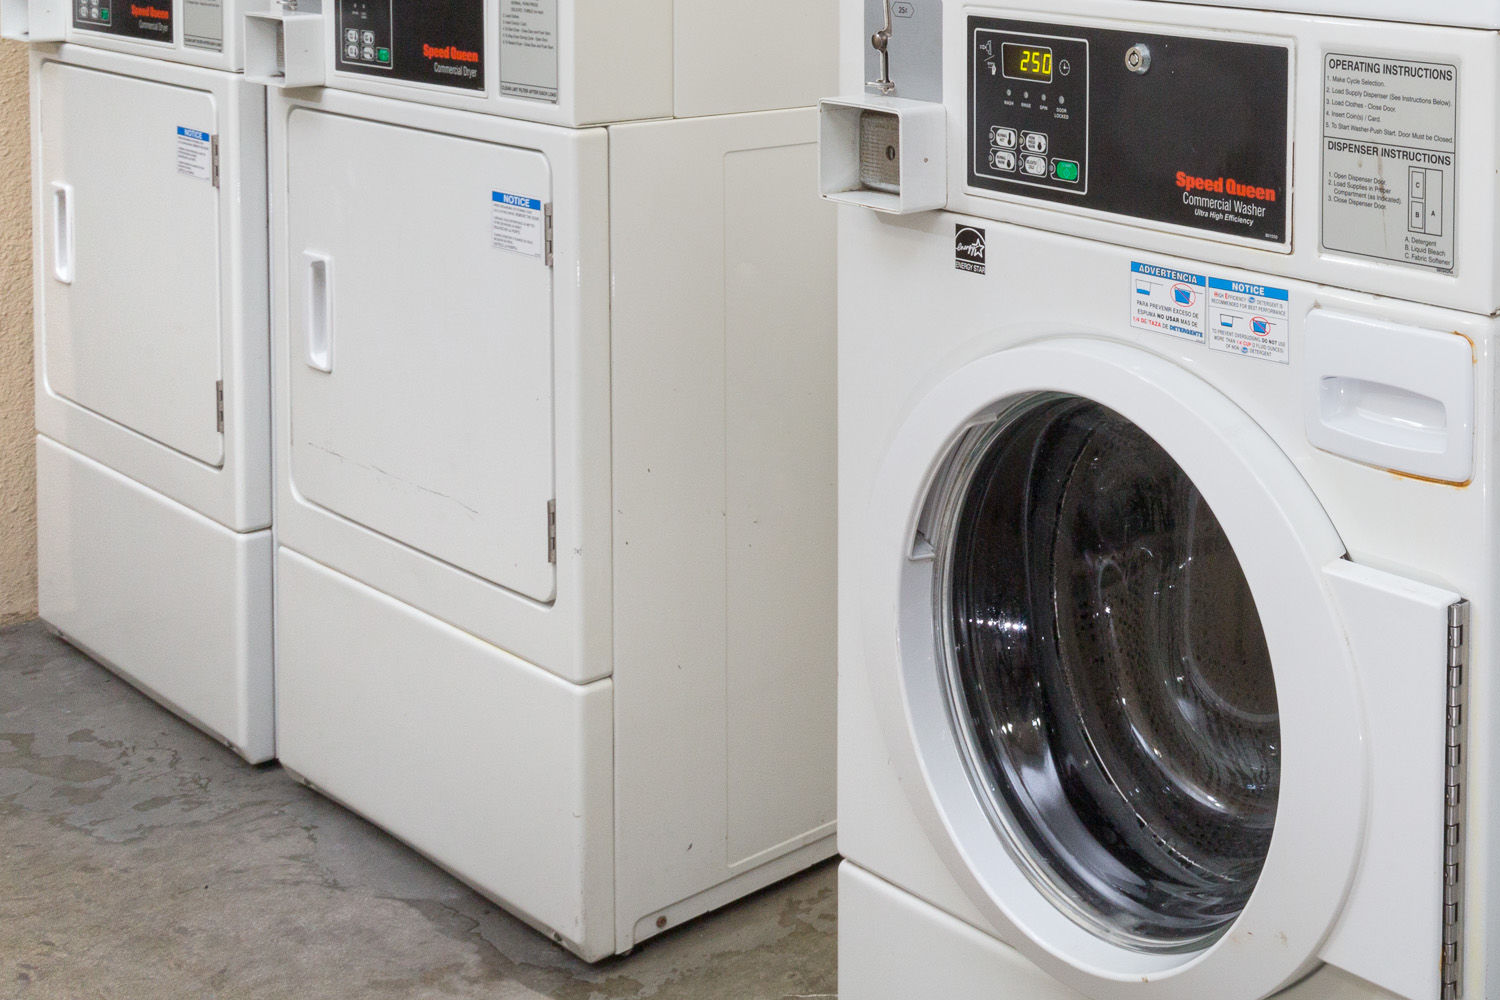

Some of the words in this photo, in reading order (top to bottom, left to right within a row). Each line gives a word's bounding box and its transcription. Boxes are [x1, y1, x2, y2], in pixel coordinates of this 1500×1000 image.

[424, 44, 449, 59] Speed
[451, 46, 478, 62] Queen
[1020, 51, 1051, 74] 250
[434, 62, 462, 75] Commercial
[463, 66, 477, 78] Dryer
[1328, 58, 1380, 74] OPERATING
[1382, 63, 1452, 81] INSTRUCTIONS
[1327, 140, 1379, 157] DISPENSER
[1380, 147, 1451, 166] INSTRUCTIONS
[1176, 171, 1223, 192] Speed
[1226, 178, 1276, 201] Queen
[504, 194, 530, 207] NOTICE
[1183, 192, 1231, 211] Commercial
[1234, 200, 1266, 217] Washer
[1195, 209, 1208, 217] Ultra
[1210, 210, 1223, 220] High
[1225, 214, 1254, 226] Efficiency
[1139, 264, 1197, 284] ADVERTENCIA
[1232, 282, 1264, 295] NOTICE
